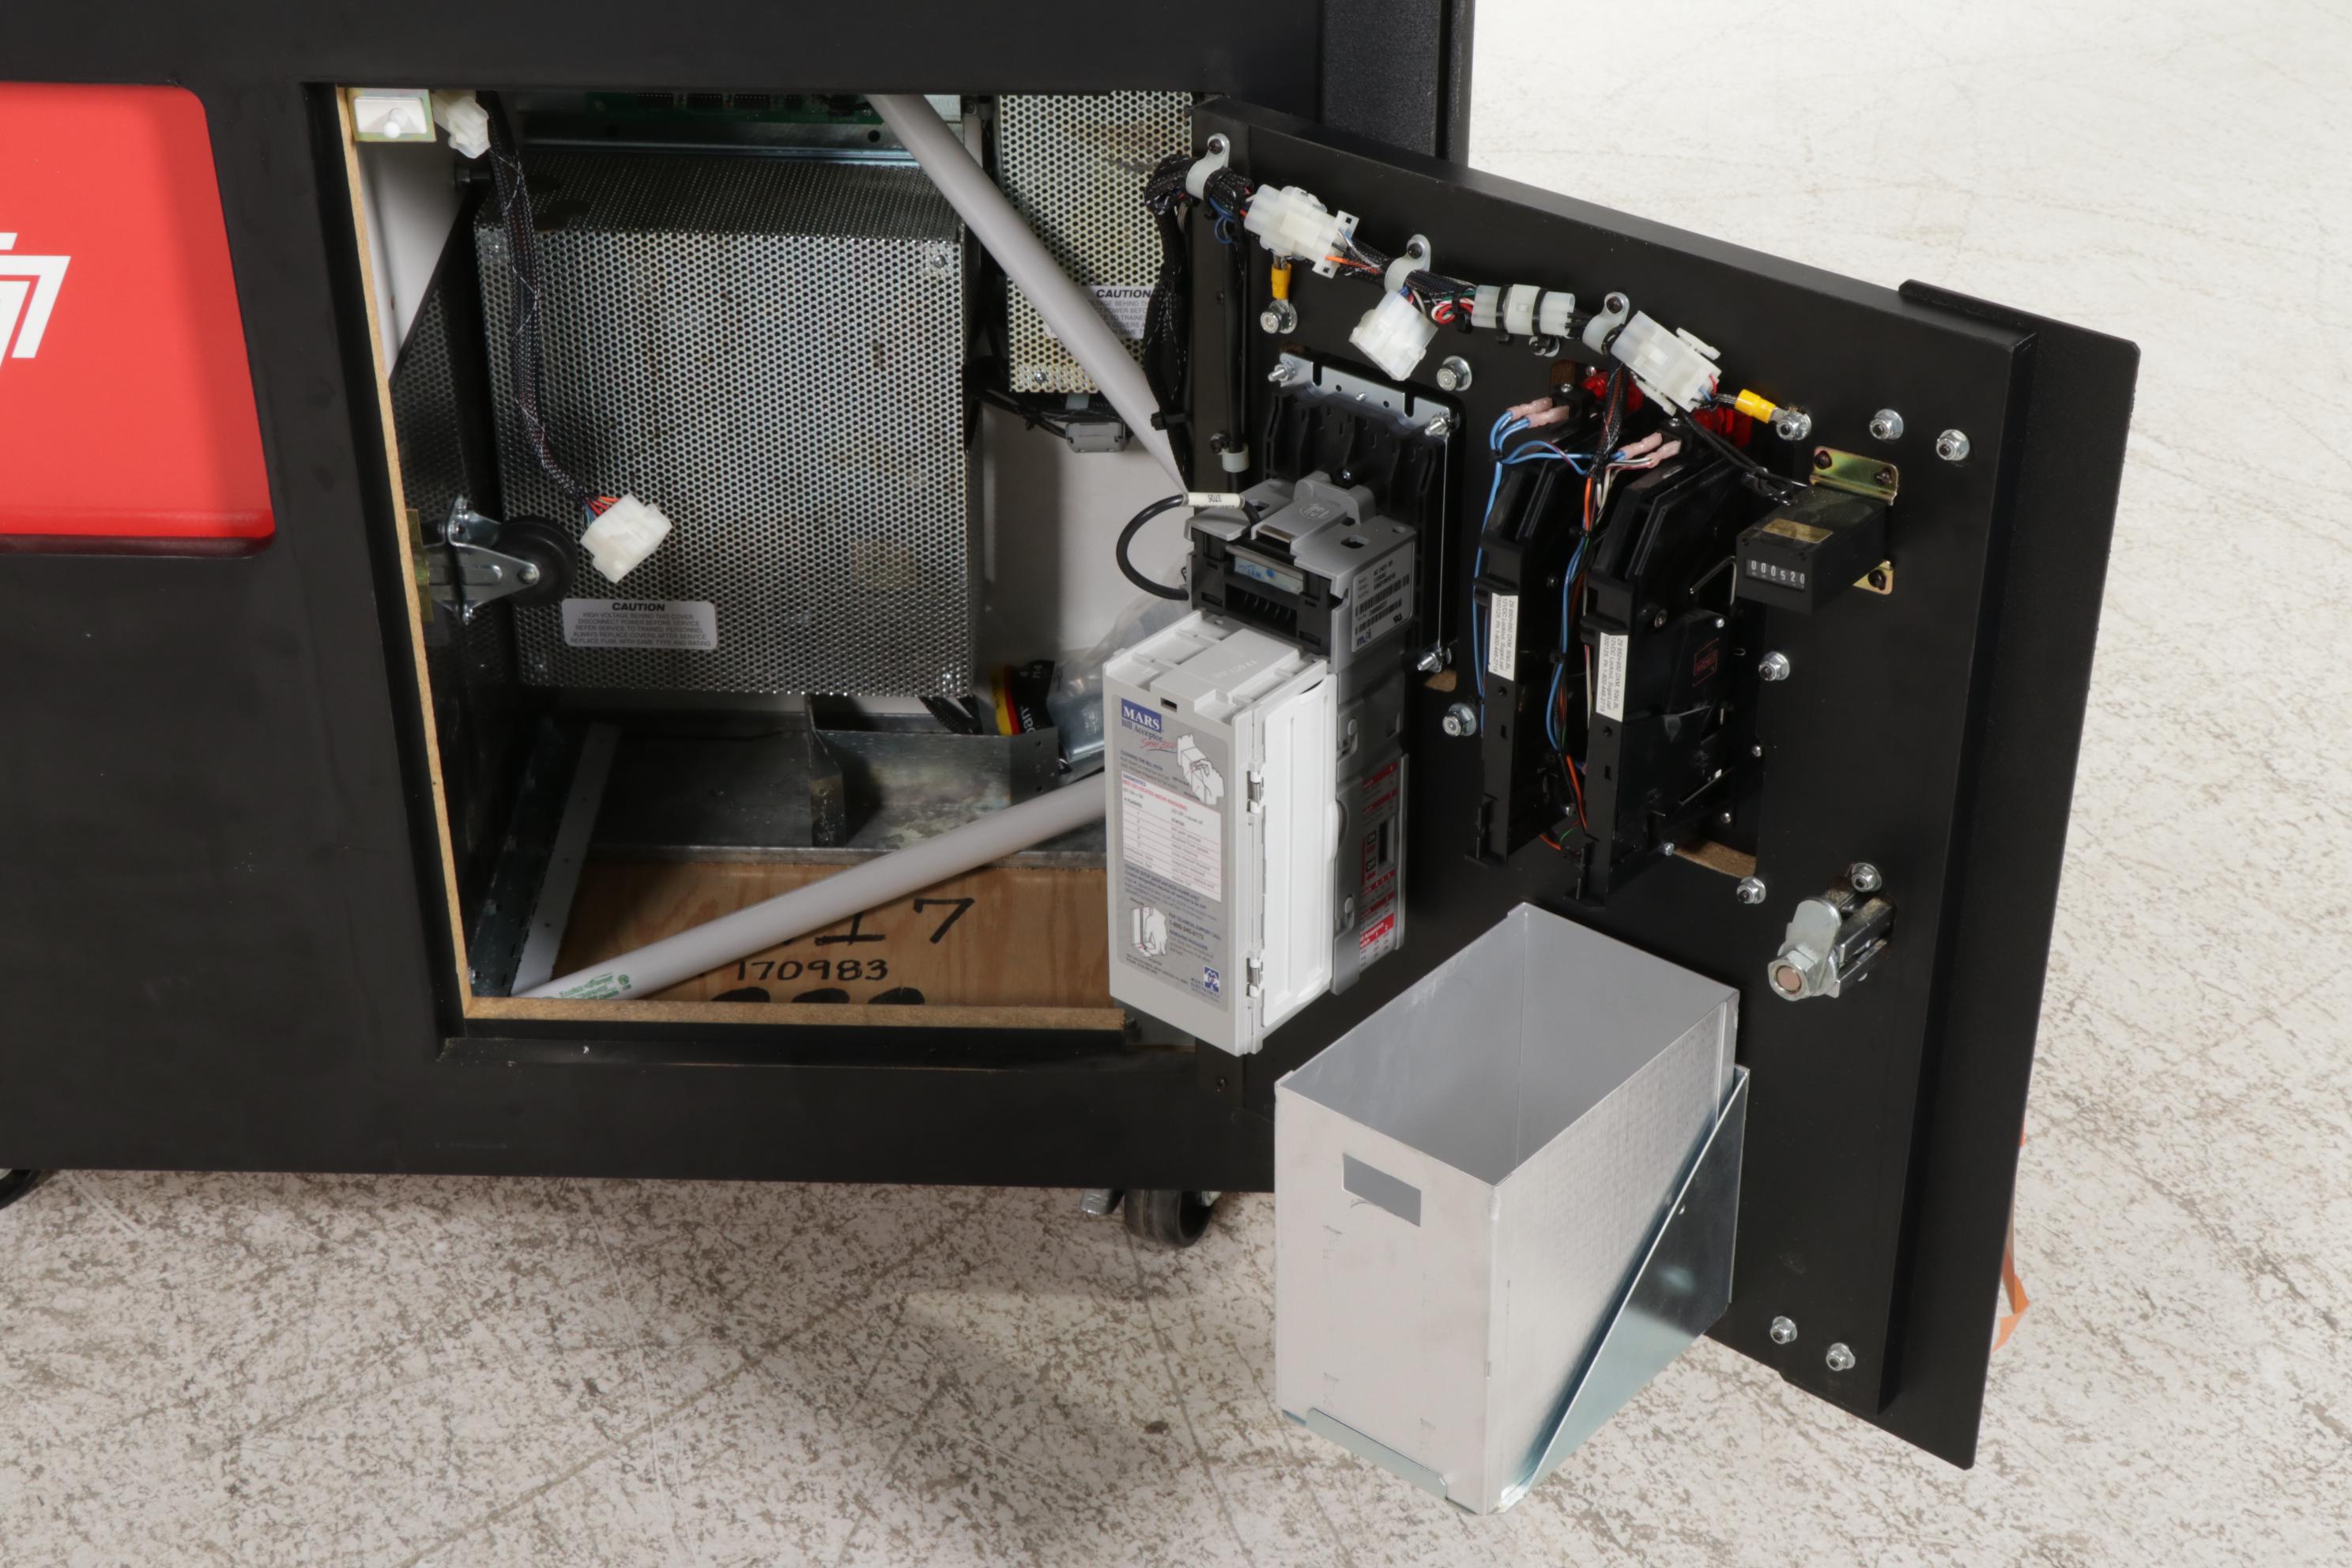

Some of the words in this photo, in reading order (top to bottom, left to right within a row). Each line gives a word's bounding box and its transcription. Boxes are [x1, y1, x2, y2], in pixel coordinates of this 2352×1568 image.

[612, 602, 665, 611] CAUTION
[1123, 706, 1159, 729] MARS
[1121, 718, 1132, 729] Bill
[1133, 725, 1163, 744] Acceptor
[738, 958, 890, 982] 170983
